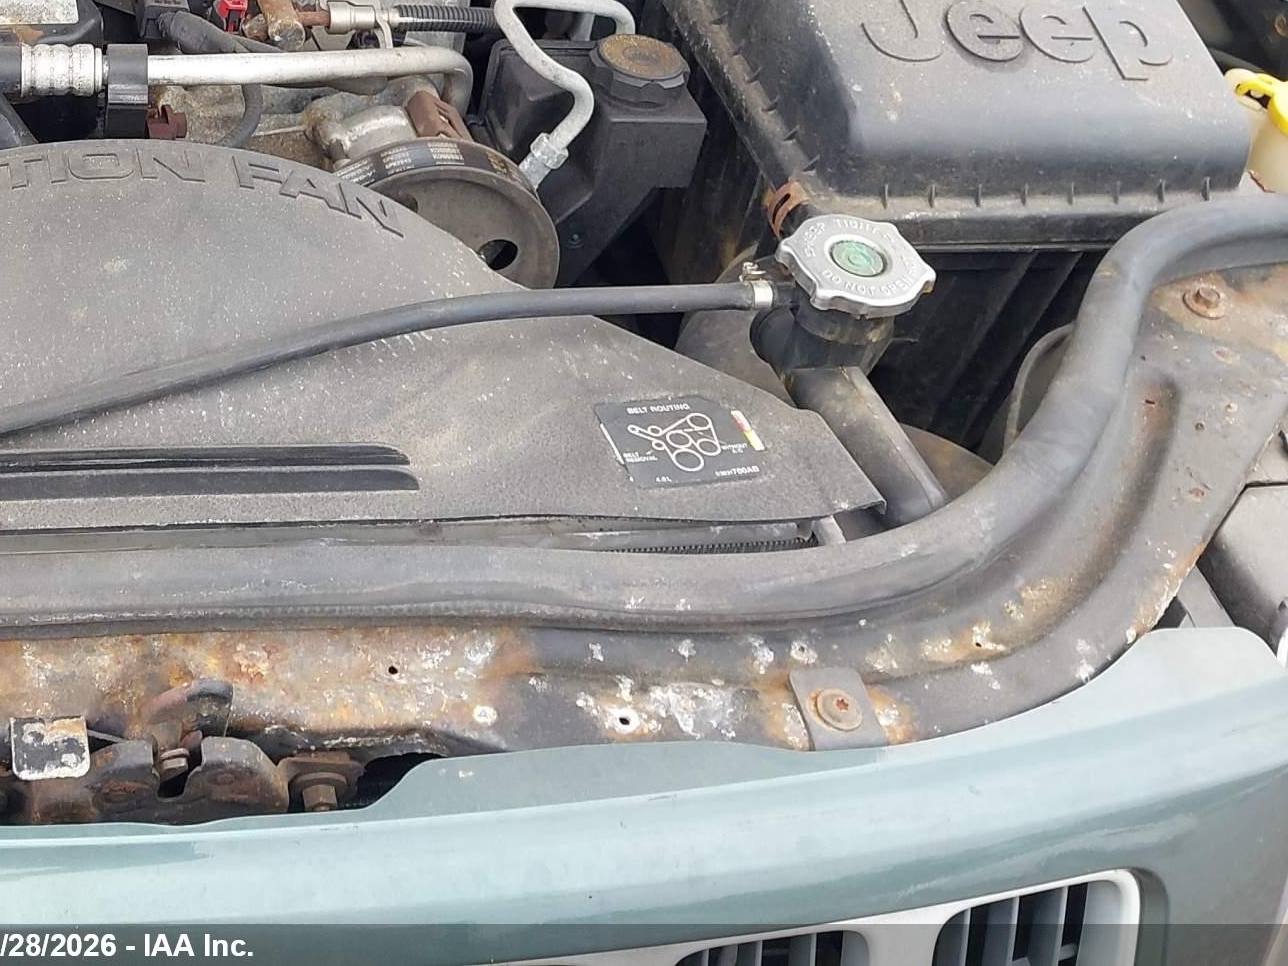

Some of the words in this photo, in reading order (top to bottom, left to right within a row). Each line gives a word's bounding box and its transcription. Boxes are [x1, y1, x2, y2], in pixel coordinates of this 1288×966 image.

[232, 154, 406, 240] FAN
[626, 406, 648, 415] BELT
[650, 402, 691, 412] ROUTING
